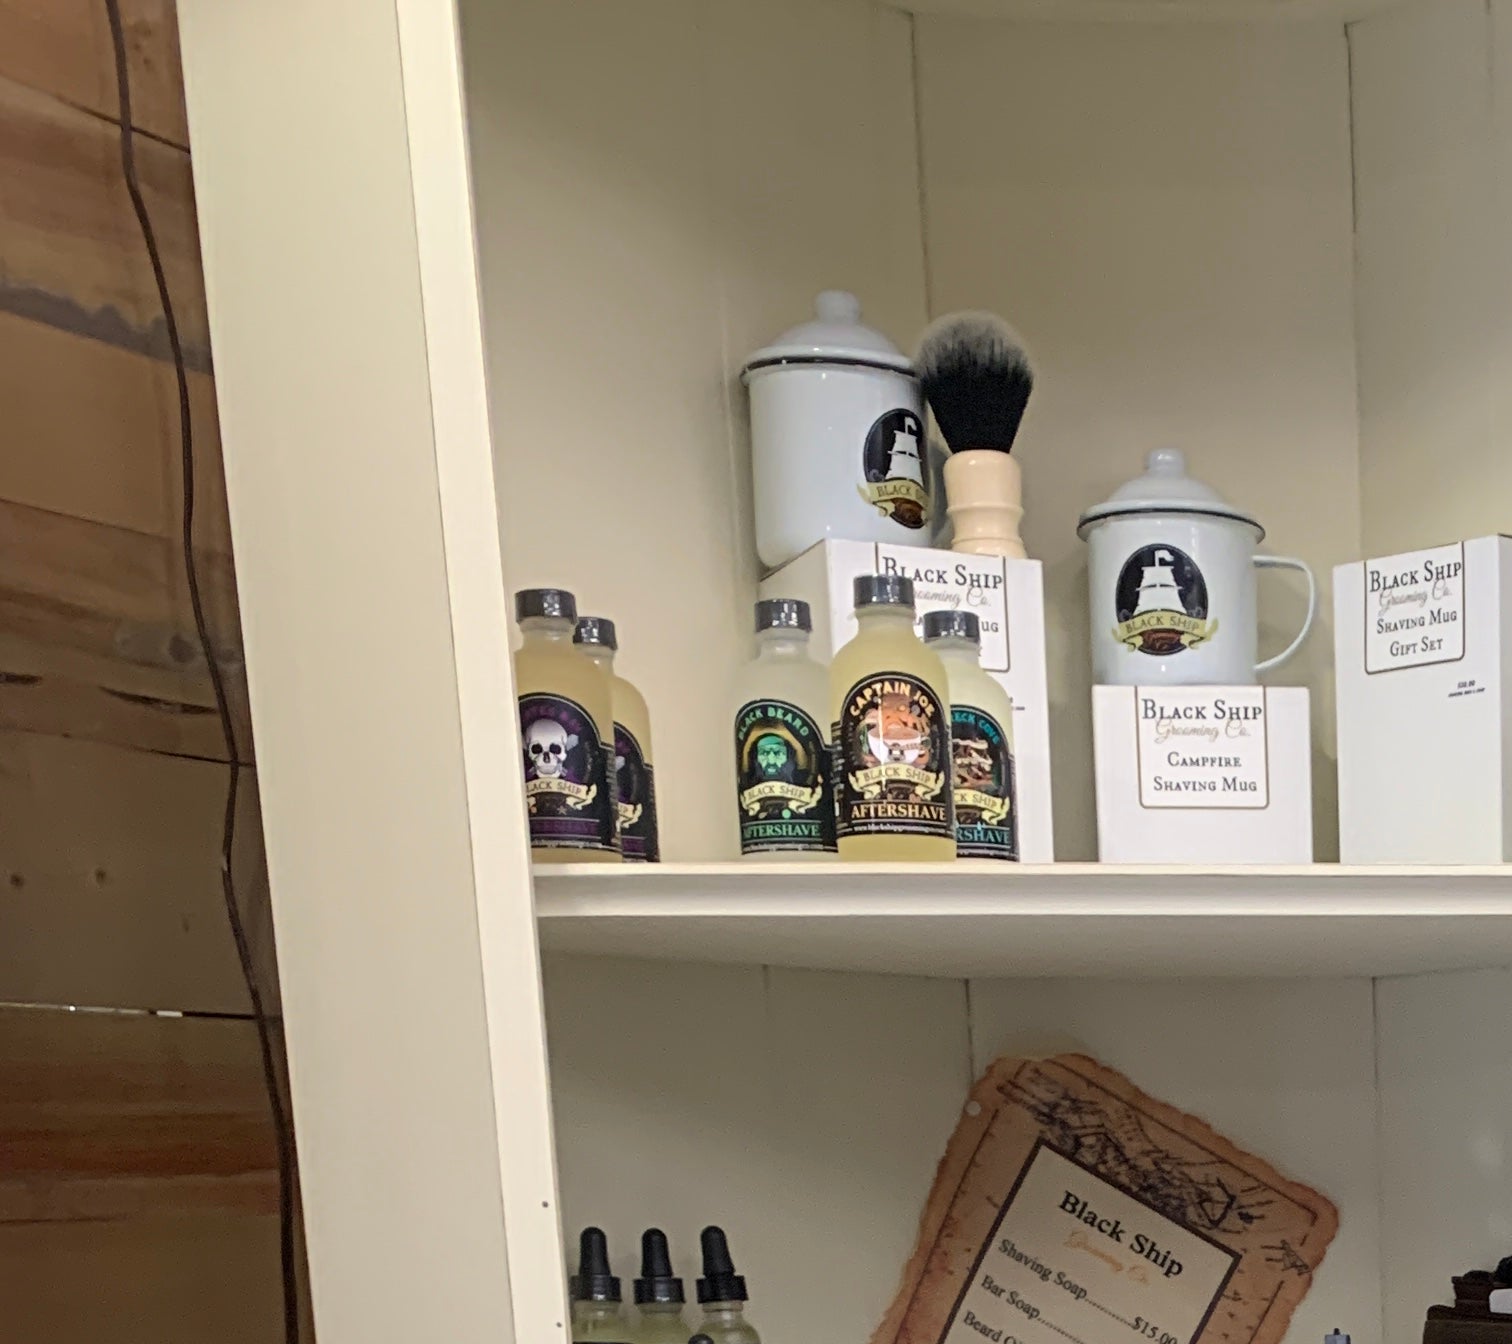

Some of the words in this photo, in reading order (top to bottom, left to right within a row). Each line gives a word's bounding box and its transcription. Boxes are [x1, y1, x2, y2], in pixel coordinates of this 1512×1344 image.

[955, 563, 1003, 589] SHIP
[1369, 569, 1419, 593] BLACK
[1424, 560, 1462, 582] SHIP
[981, 620, 999, 633] UG
[1125, 615, 1164, 633] BLACK
[1169, 615, 1200, 632] SHIP
[1376, 615, 1425, 634] SHAVING
[1428, 607, 1458, 625] MUG
[1390, 640, 1418, 657] GIFT
[1420, 636, 1444, 652] SET
[850, 680, 911, 717] CAPTAIN
[913, 689, 936, 717] JOE
[1142, 698, 1207, 720] BLACK
[1213, 699, 1263, 720] SHIP
[738, 707, 764, 741] BLACK
[767, 706, 809, 737] BEARD
[1154, 719, 1220, 743] Grooming
[1167, 751, 1242, 768] CAMPFIRE
[863, 765, 901, 781] BLACK
[905, 767, 932, 784] SHIP
[1153, 776, 1217, 793] SHAVING
[1221, 777, 1258, 793] MUG
[525, 780, 553, 794] LACK
[556, 782, 582, 798] SHIP
[747, 785, 775, 800] BLACK
[779, 785, 806, 799] SHIP
[851, 802, 947, 821] AFTERSHAVE
[972, 795, 998, 809] SHIP
[957, 828, 1010, 845] RSHAVE
[1058, 1190, 1126, 1243] Black
[1129, 1233, 1184, 1279] Ship
[998, 1238, 1053, 1282] Shaving
[981, 1274, 1006, 1298] Bar
[963, 1310, 1003, 1343] Beard
